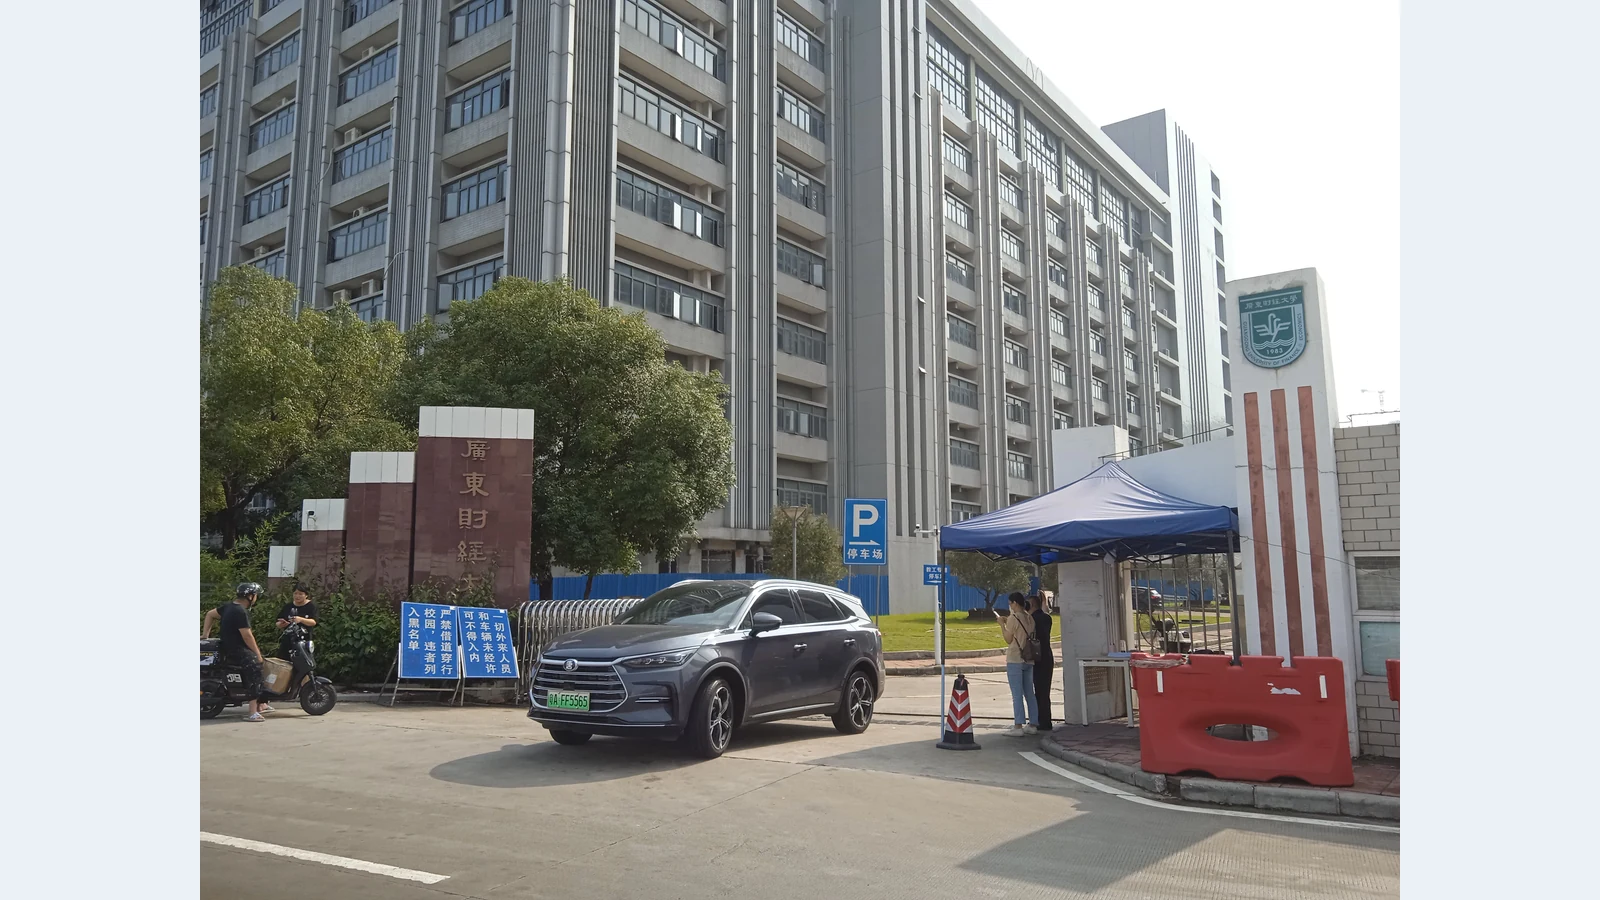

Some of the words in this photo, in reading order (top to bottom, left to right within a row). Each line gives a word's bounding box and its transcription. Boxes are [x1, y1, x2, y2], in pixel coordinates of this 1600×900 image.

[853, 504, 879, 537] P
[847, 548, 883, 560] 停车场
[408, 607, 420, 651] 入黑名单
[440, 609, 453, 675] 严禁借道穿行
[463, 611, 480, 663] 可不得入内
[478, 611, 497, 674] 和车辆未经许
[493, 614, 512, 674] 一切外来人员
